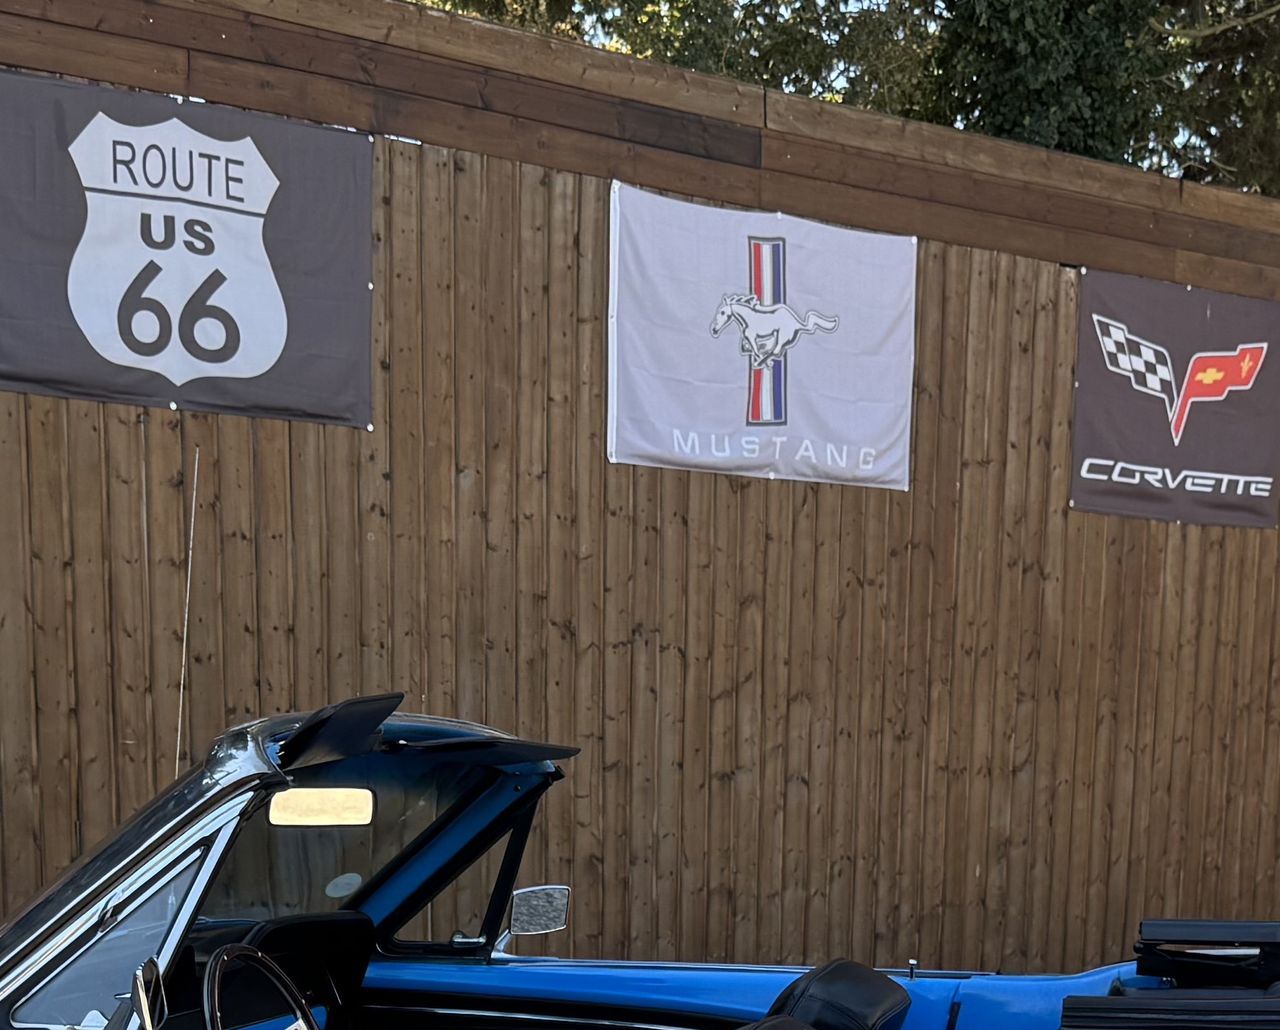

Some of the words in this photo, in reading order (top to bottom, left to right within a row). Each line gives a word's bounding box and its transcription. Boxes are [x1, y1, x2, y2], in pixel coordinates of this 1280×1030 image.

[112, 139, 245, 203] ROUTE
[140, 212, 216, 256] US
[116, 259, 241, 364] 66
[672, 428, 877, 470] MUSTANG
[1080, 457, 1274, 497] CORVETTE
